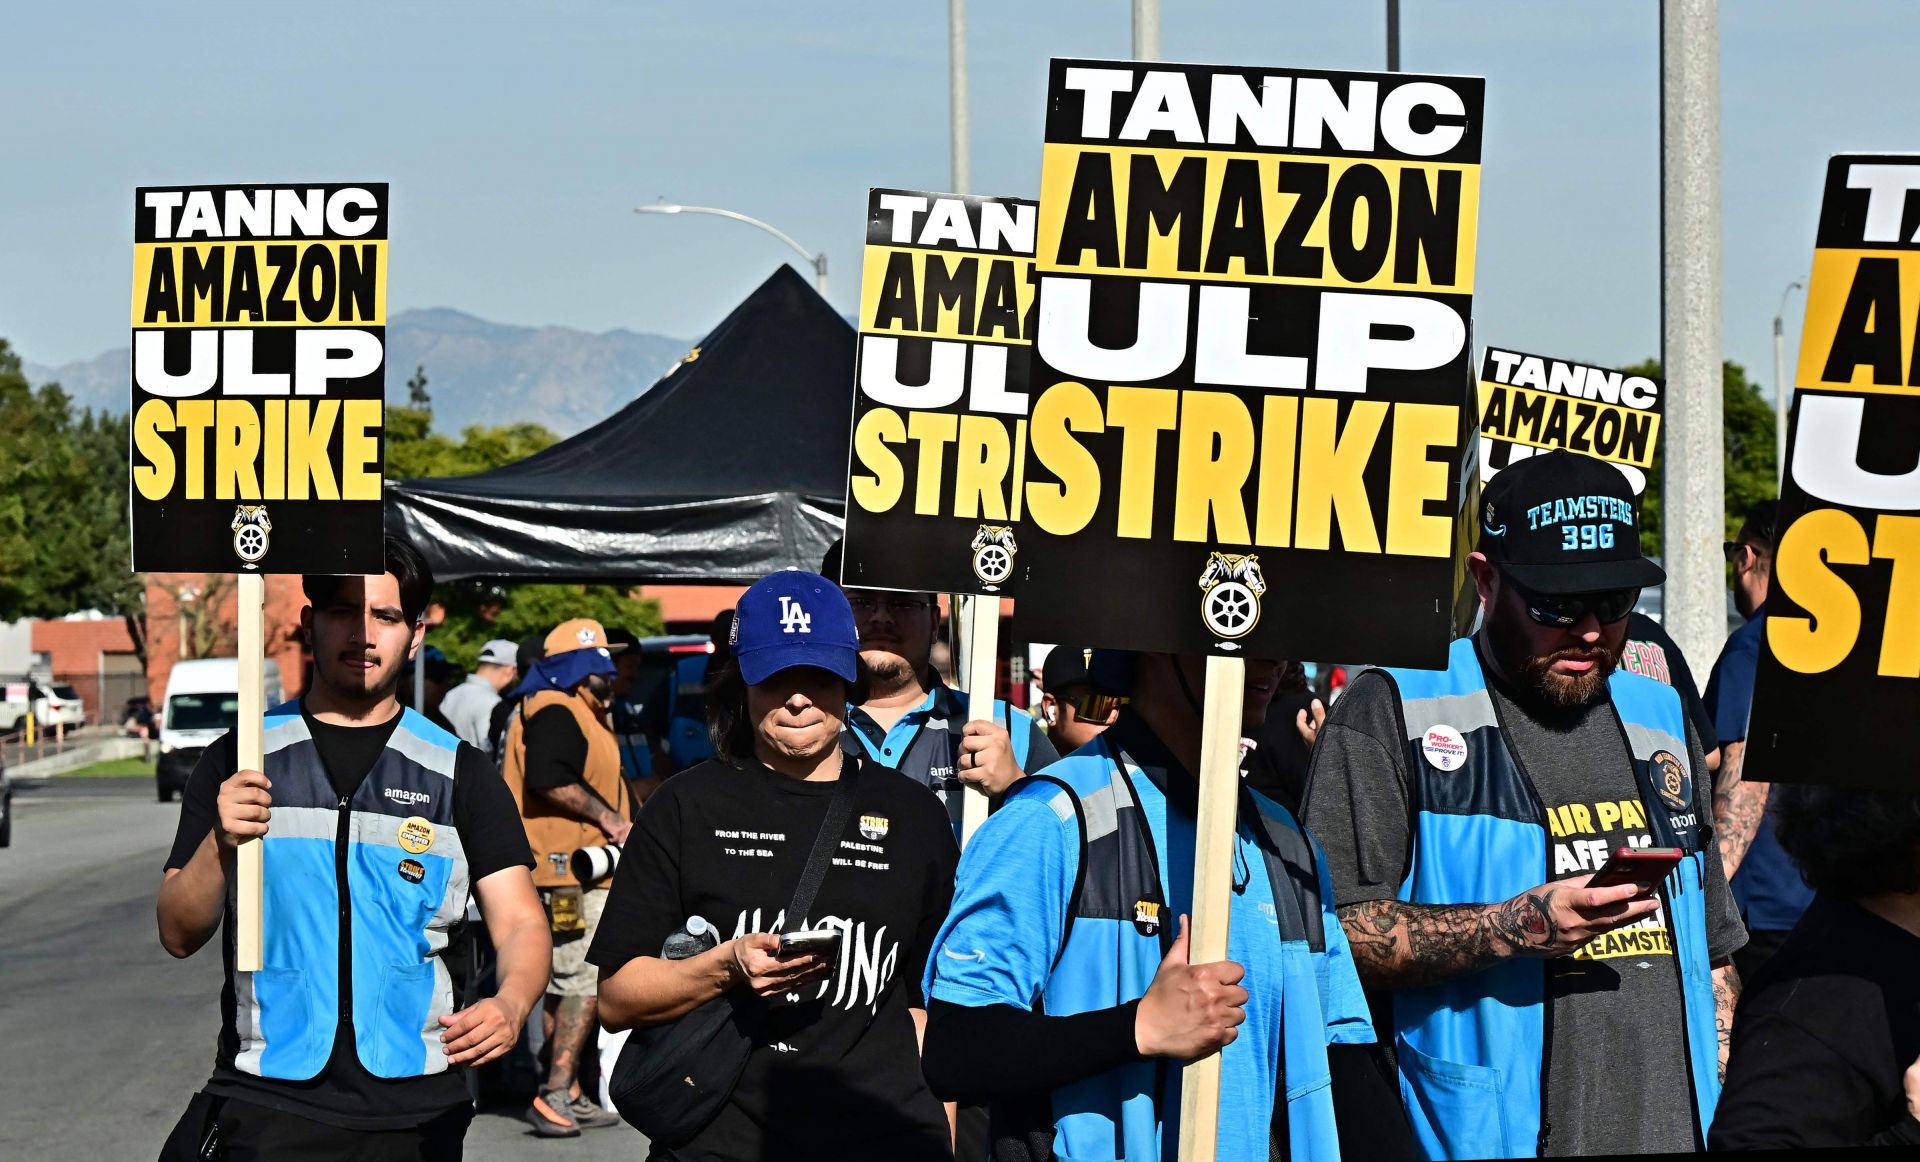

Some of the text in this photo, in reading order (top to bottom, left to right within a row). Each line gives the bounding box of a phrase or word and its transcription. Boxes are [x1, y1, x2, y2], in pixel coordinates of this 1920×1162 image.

[1065, 68, 1467, 156] TANNC
[144, 187, 378, 238] TANNC
[1056, 152, 1462, 286] AMAZON
[1846, 163, 1920, 243] T
[143, 243, 377, 323] AMAZON
[1037, 277, 1467, 393] ULP
[1821, 256, 1920, 388] A
[135, 329, 384, 398] ULP
[1491, 350, 1658, 410] TANNC
[133, 398, 383, 501] STRIKE
[1480, 387, 1652, 463] AMAZON
[1025, 381, 1460, 558] STRIKE
[1527, 495, 1633, 531] TEAMSTERS
[1562, 523, 1615, 550] 396
[778, 596, 811, 633] LA
[385, 787, 430, 804] amazon
[408, 822, 430, 834] AMAZON
[715, 830, 786, 841] FROM THE RIVER
[840, 840, 884, 854] PALESTINE
[860, 815, 889, 828] STRIKE
[400, 862, 424, 874] STRIKE
[724, 847, 774, 857] TO THE SEA
[832, 857, 890, 870] WILL BE FREE
